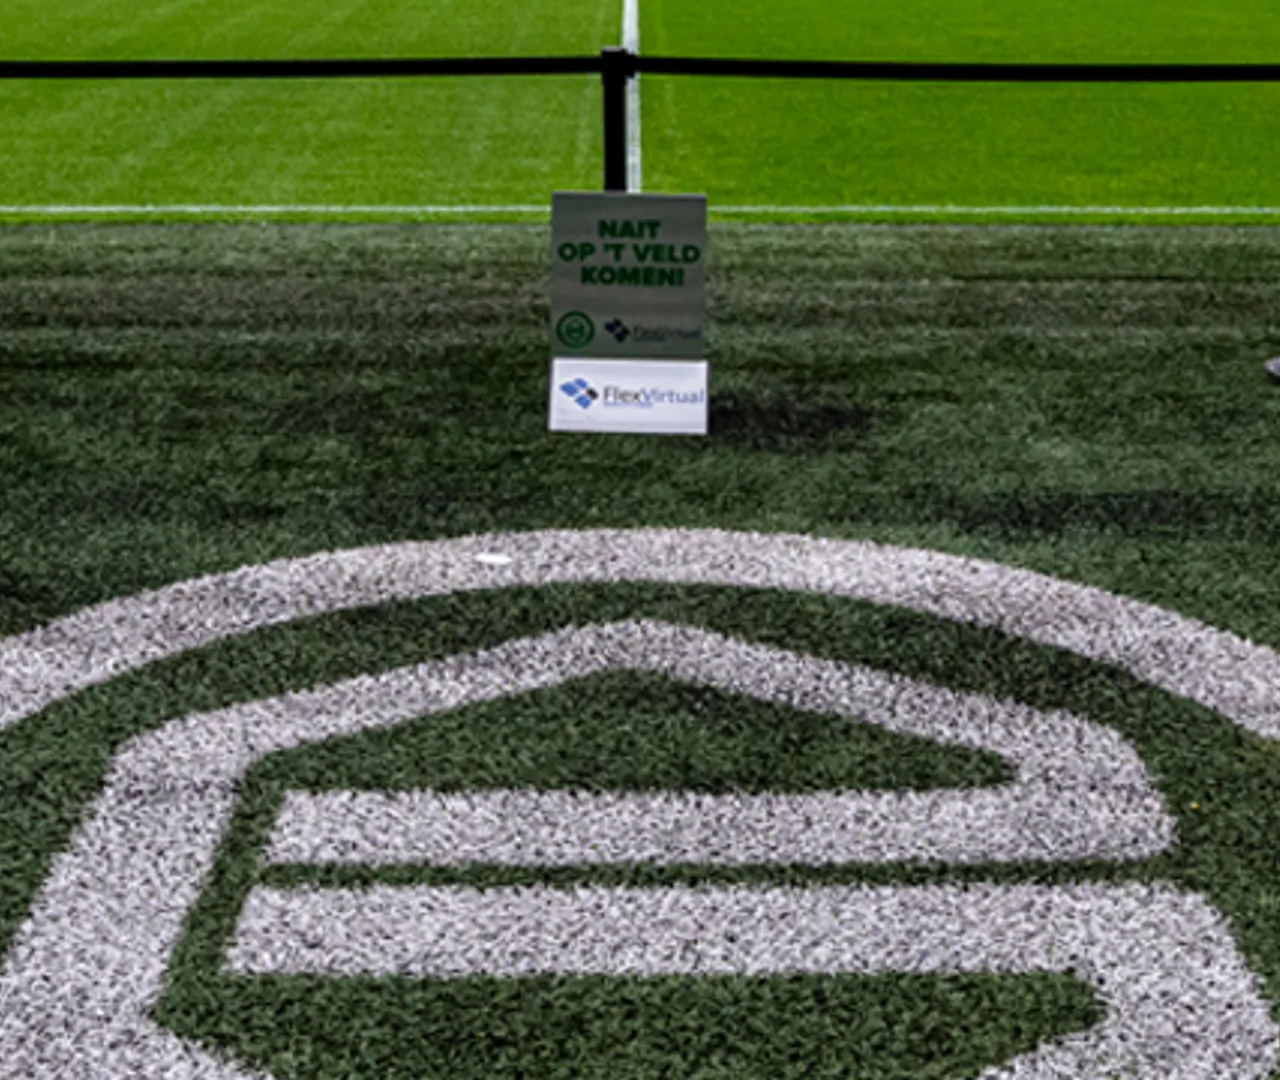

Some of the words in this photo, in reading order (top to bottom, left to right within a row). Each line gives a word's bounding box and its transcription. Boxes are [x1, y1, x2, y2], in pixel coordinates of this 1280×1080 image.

[598, 219, 661, 239] NAIT
[558, 243, 596, 262] OP
[604, 243, 624, 262] 'T
[632, 244, 701, 263] VELD
[581, 266, 684, 287] KOMEN!
[603, 384, 705, 405] FlexVirtual
